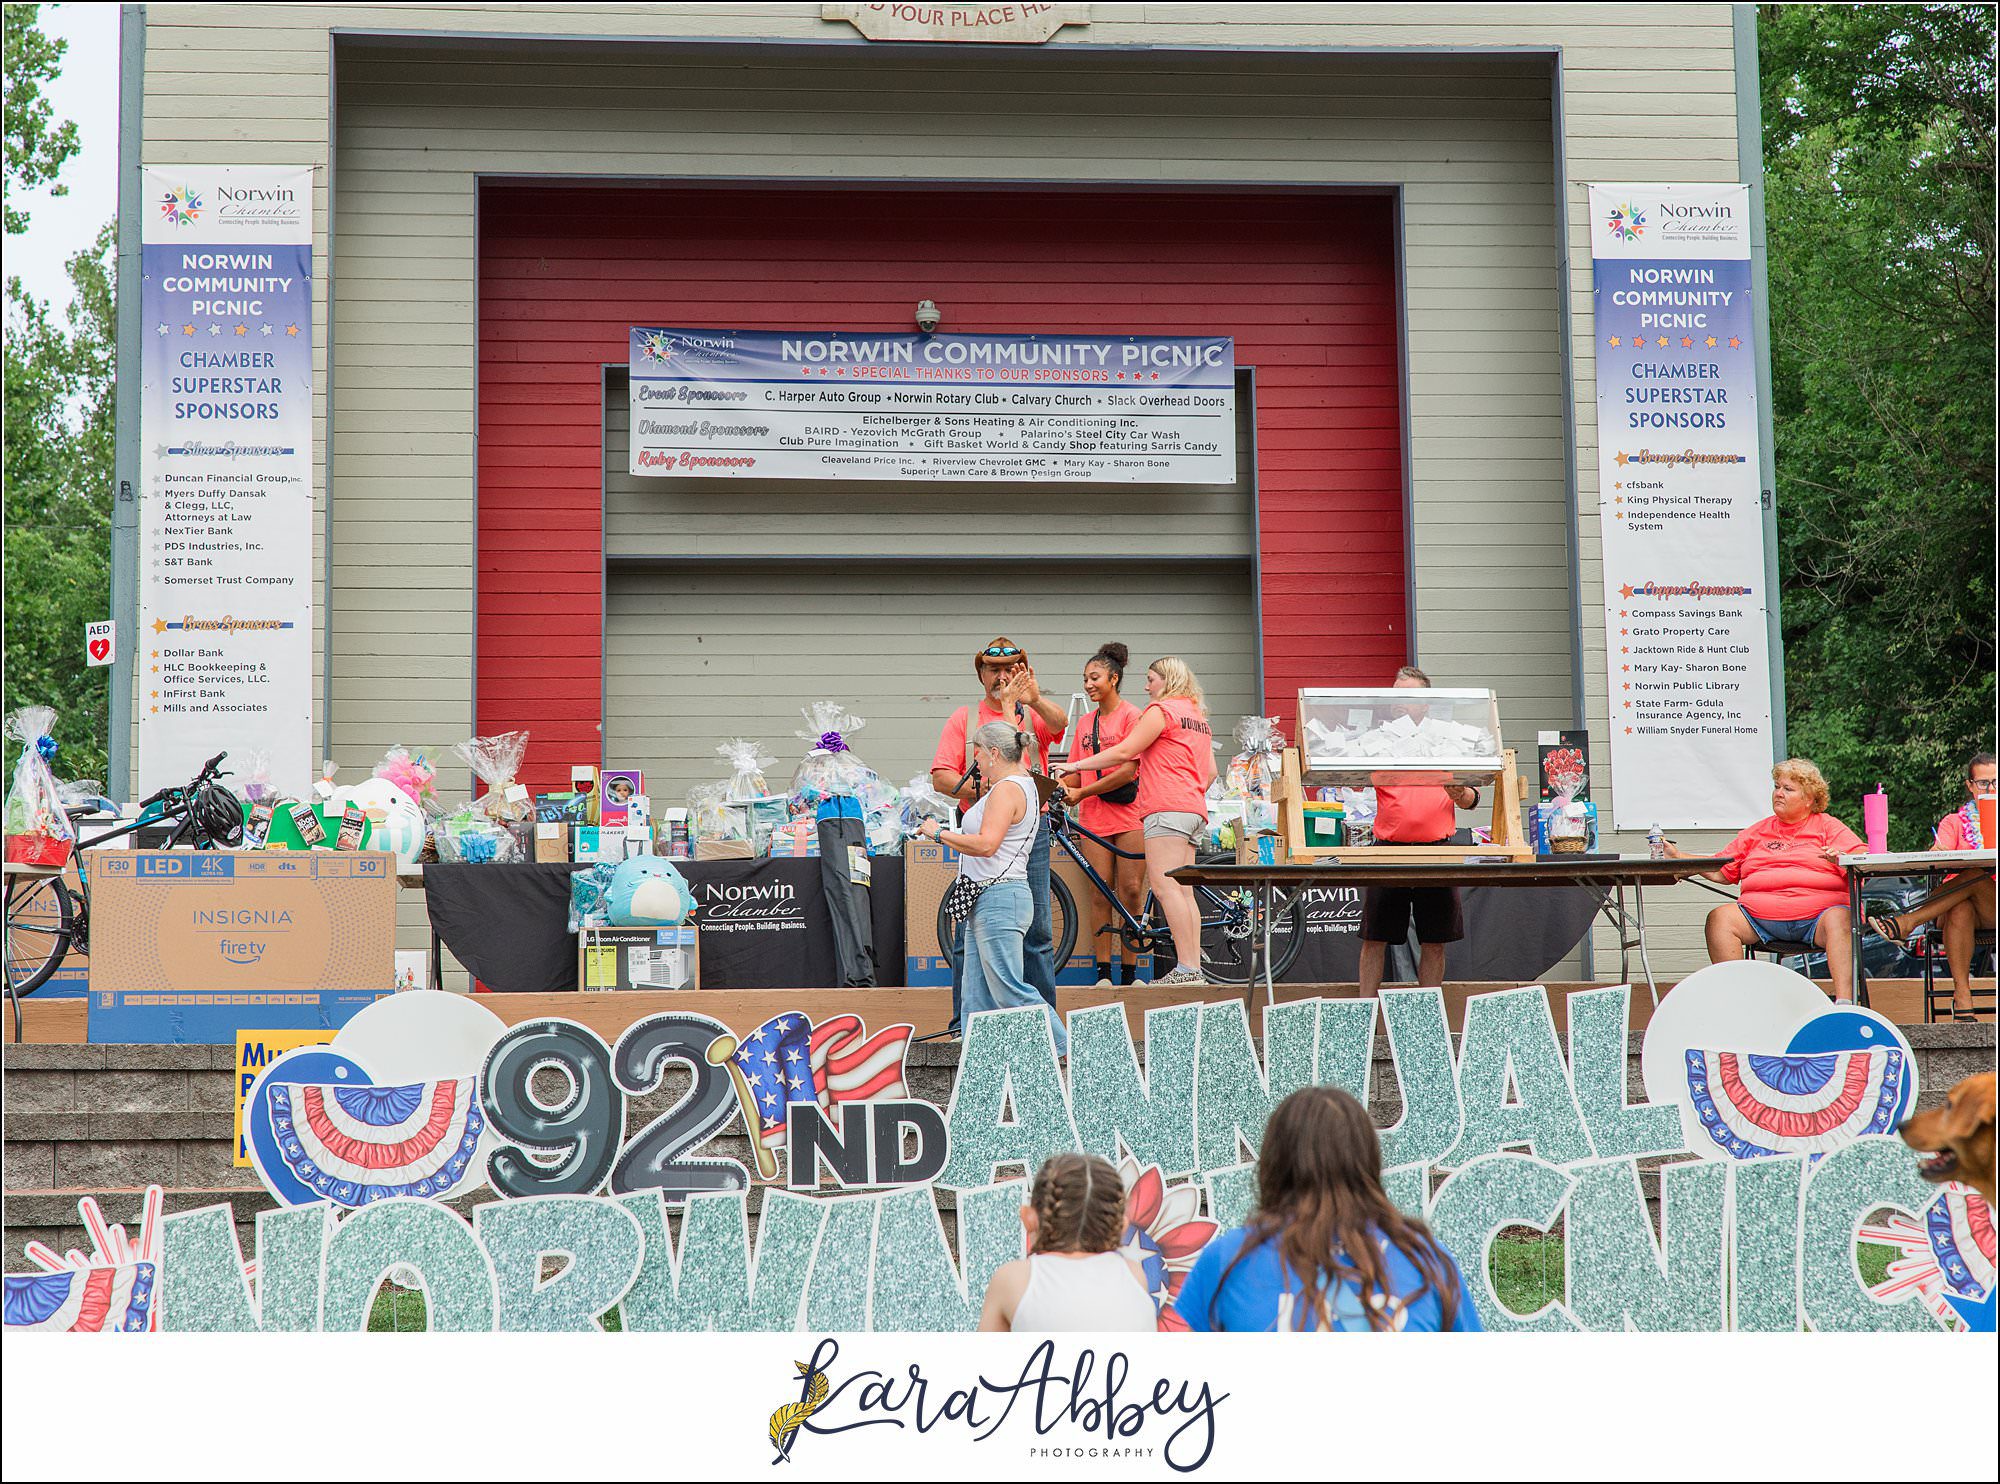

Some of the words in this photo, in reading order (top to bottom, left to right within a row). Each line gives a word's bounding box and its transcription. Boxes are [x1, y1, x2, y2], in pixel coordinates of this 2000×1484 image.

[890, 4, 944, 26] YOUR
[952, 7, 1015, 26] PLACE
[218, 185, 295, 202] Norwin
[219, 201, 300, 215] Chamber
[1660, 201, 1732, 219] Norwin
[1663, 217, 1738, 232] Chamber
[182, 254, 272, 269] NORWIN
[1630, 269, 1713, 284] NORWIN
[163, 277, 292, 293] COMMUNITY
[1612, 291, 1733, 306] COMMUNITY
[191, 300, 263, 316] PICNIC
[1641, 313, 1707, 328] PICNIC
[682, 336, 735, 349] Norwin
[180, 352, 274, 368] CHAMBER
[781, 340, 913, 363] NORWIN
[923, 341, 1113, 366] COMMUNITY
[1122, 344, 1224, 367] PICNIC
[852, 367, 912, 380] SPECIAL
[916, 367, 972, 380] THANKS
[977, 368, 995, 380] TO
[999, 369, 1030, 381] OUR
[1034, 370, 1109, 382] SPONSORS
[1631, 363, 1720, 379] CHAMBER
[172, 377, 282, 393] SUPERSTAR
[638, 385, 676, 401] Event
[765, 390, 776, 402] C.
[779, 390, 816, 403] Harper
[819, 391, 845, 403] Auto
[848, 391, 881, 405] Group
[894, 392, 933, 404] Norwin
[936, 392, 971, 407] Rotary
[975, 392, 999, 405] Club
[1011, 394, 1051, 407] Calvary
[1054, 394, 1092, 406] Church
[1107, 395, 1136, 407] Slack
[1139, 395, 1191, 407] Overhead
[1193, 396, 1225, 407] Doors
[1625, 387, 1728, 404] SUPERSTAR
[175, 403, 279, 419] SPONSORS
[638, 419, 697, 436] Diamond
[862, 415, 931, 427] Eichelberger
[934, 417, 942, 427] &
[944, 417, 970, 427] Sons
[973, 417, 1015, 429] Heating
[1018, 418, 1026, 427] &
[1029, 417, 1045, 427] Air
[1047, 418, 1116, 429] Conditioning
[1119, 418, 1139, 428] Inc.
[1629, 412, 1726, 429] SPONSORS
[183, 441, 222, 457] Silver
[223, 440, 283, 461] Sponsors
[779, 436, 804, 446] Club
[807, 437, 832, 447] Pure
[834, 438, 899, 450] Imagination
[924, 439, 945, 450] Gift
[947, 440, 983, 450] Basket
[986, 440, 1019, 450] World
[1022, 440, 1030, 450] &
[1032, 440, 1066, 452] Candy
[1069, 440, 1097, 452] Shop
[1099, 441, 1148, 452] featuring
[1151, 441, 1182, 451] Sarris
[1184, 441, 1218, 453] Candy
[638, 450, 677, 470] Ruby
[1638, 448, 1682, 469] Bronze
[1683, 448, 1739, 469] Sponsors
[1626, 481, 1664, 489] cfsbank
[164, 489, 195, 499] Myers
[198, 489, 226, 499] Duffy
[229, 489, 267, 498] Dansak
[1627, 496, 1649, 505] King
[1652, 496, 1691, 505] Physical
[1694, 496, 1733, 505] Therapy
[164, 513, 215, 522] Attorneys
[218, 513, 229, 522] at
[231, 513, 252, 522] Law
[1628, 511, 1696, 520] Independence
[1699, 511, 1730, 520] Health
[164, 527, 204, 535] NexTier
[208, 527, 233, 535] Bank
[1628, 522, 1663, 532] System
[164, 558, 183, 566] S&T
[187, 558, 213, 566] Bank
[164, 576, 213, 585] Somerset
[216, 576, 242, 585] Trust
[245, 576, 294, 586] Company
[1643, 580, 1688, 601] Copper
[1689, 580, 1745, 601] Sponsors
[1631, 610, 1676, 619] Compass
[1678, 609, 1716, 618] Savings
[1718, 609, 1743, 617] Bank
[89, 624, 110, 636] AED
[182, 614, 220, 632] Brass
[221, 614, 283, 636] Sponsors
[1632, 628, 1660, 636] Grato
[1663, 628, 1705, 637] Property
[1707, 628, 1730, 636] Care
[163, 649, 195, 657] Dollar
[198, 649, 224, 657] Bank
[163, 663, 185, 672] HLC
[188, 663, 257, 673] Bookkeeping
[259, 663, 266, 672] &
[163, 675, 195, 684] Office
[198, 675, 244, 684] Services,
[247, 675, 270, 683] LLC.
[1635, 682, 1670, 690] Norwin
[1673, 682, 1703, 690] Public
[1705, 681, 1740, 691] Library
[163, 689, 197, 698] InFirst
[200, 689, 226, 698] Bank
[163, 704, 187, 712] Mills
[189, 704, 208, 712] and
[212, 703, 268, 712] Associates
[1636, 711, 1683, 719] Insurance
[1685, 711, 1725, 720] Agency,
[1727, 710, 1742, 719] Inc
[1637, 726, 1668, 734] William
[1670, 726, 1700, 735] Snyder
[1701, 725, 1732, 734] Funeral
[1734, 725, 1758, 734] Home
[920, 848, 938, 857] F30
[108, 861, 129, 870] F30
[144, 858, 183, 874] LED
[201, 857, 224, 871] 4K
[706, 878, 796, 901] Norwin
[707, 898, 801, 917] Chamber
[193, 910, 291, 925] INSIGNIA
[701, 923, 734, 932] Connecting
[735, 922, 755, 933] People.
[756, 922, 780, 931] Building
[780, 921, 807, 930] Business.
[932, 984, 1688, 1190] ANNUAL
[482, 1011, 750, 1202] 92
[786, 1099, 949, 1191] ND
